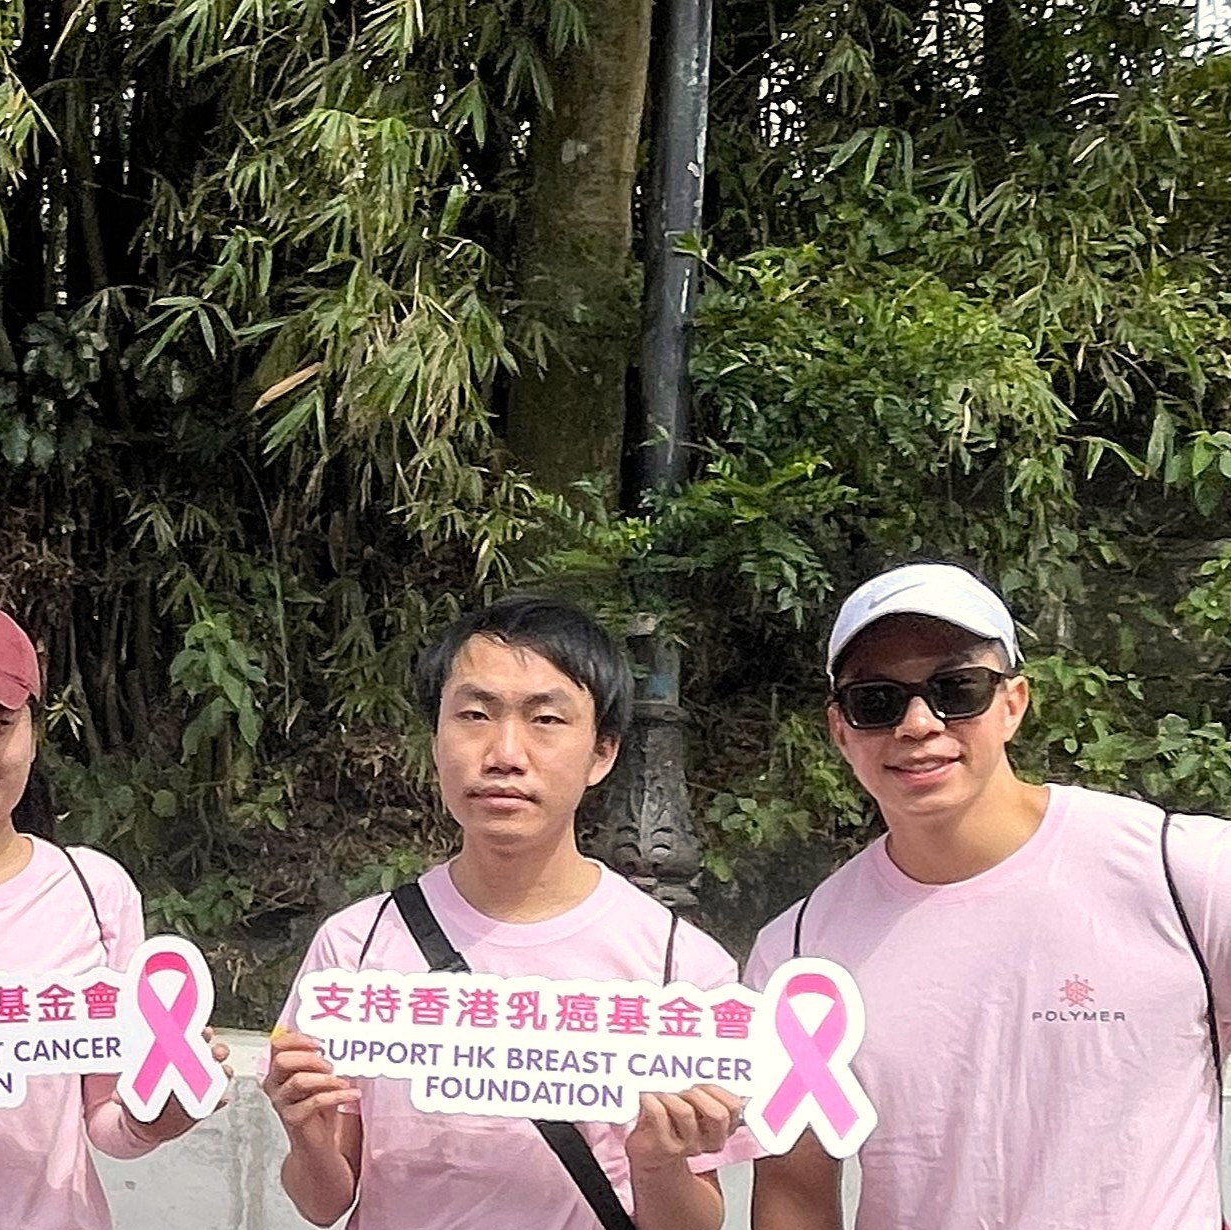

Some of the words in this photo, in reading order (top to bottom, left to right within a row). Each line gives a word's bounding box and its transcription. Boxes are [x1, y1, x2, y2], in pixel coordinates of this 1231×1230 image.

[310, 983, 756, 1040] 支持香港乳癌基金會
[1032, 1011, 1126, 1022] POLYMER
[14, 1036, 122, 1063] CANCER
[453, 1042, 497, 1068] HK
[507, 1048, 618, 1076] BREAST
[628, 1054, 753, 1082] CANCER
[425, 1077, 624, 1108] FOUNDATION
